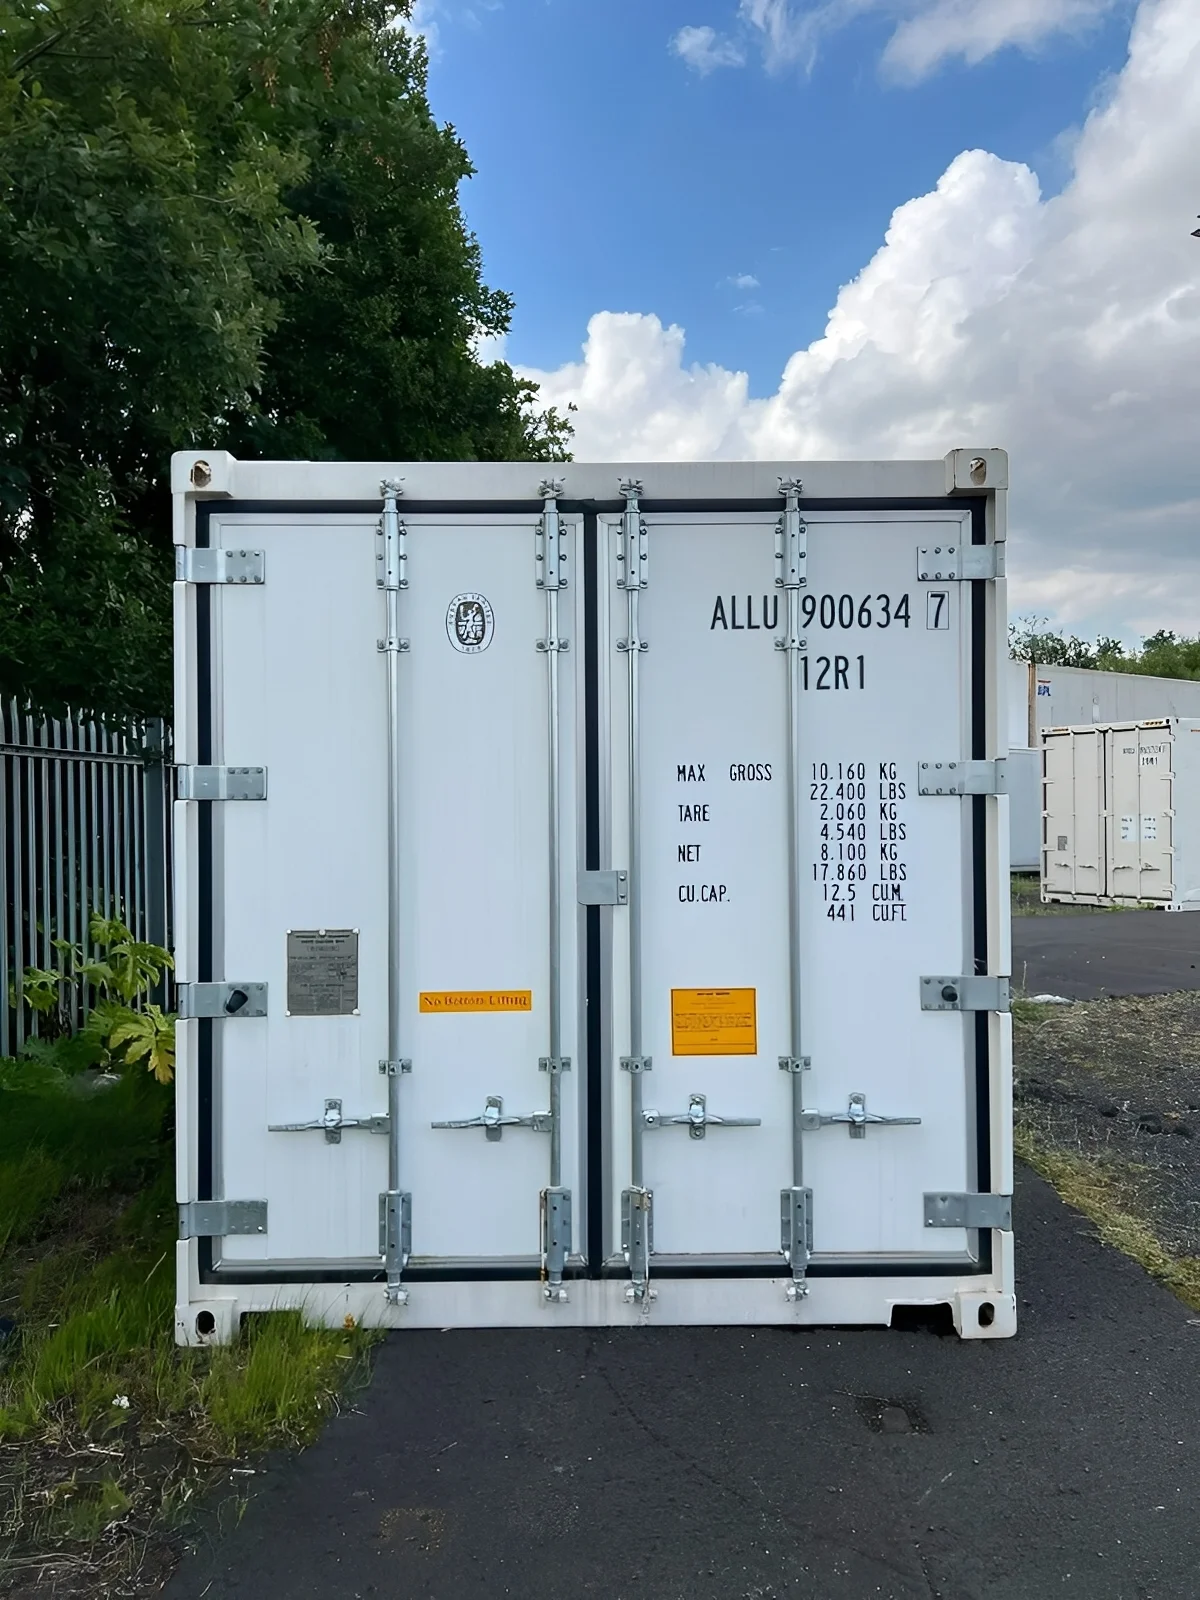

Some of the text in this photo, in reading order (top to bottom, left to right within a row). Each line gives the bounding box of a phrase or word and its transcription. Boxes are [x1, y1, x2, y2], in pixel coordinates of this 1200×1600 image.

[710, 593, 946, 630] ALLU 900634 7
[800, 655, 865, 690] 12R1
[677, 763, 897, 782] MAX GROSS 10.160 KG
[810, 783, 907, 800] 22.400 LBS
[678, 803, 897, 822] TARE 2.060 KG
[820, 823, 907, 840] 4.540 LBS
[677, 843, 898, 862] NET 8.100 KG
[812, 863, 907, 881] 17.860 LBS
[678, 885, 731, 903] CU.CAP.
[823, 884, 856, 901] 12.5
[827, 904, 855, 921] 441
